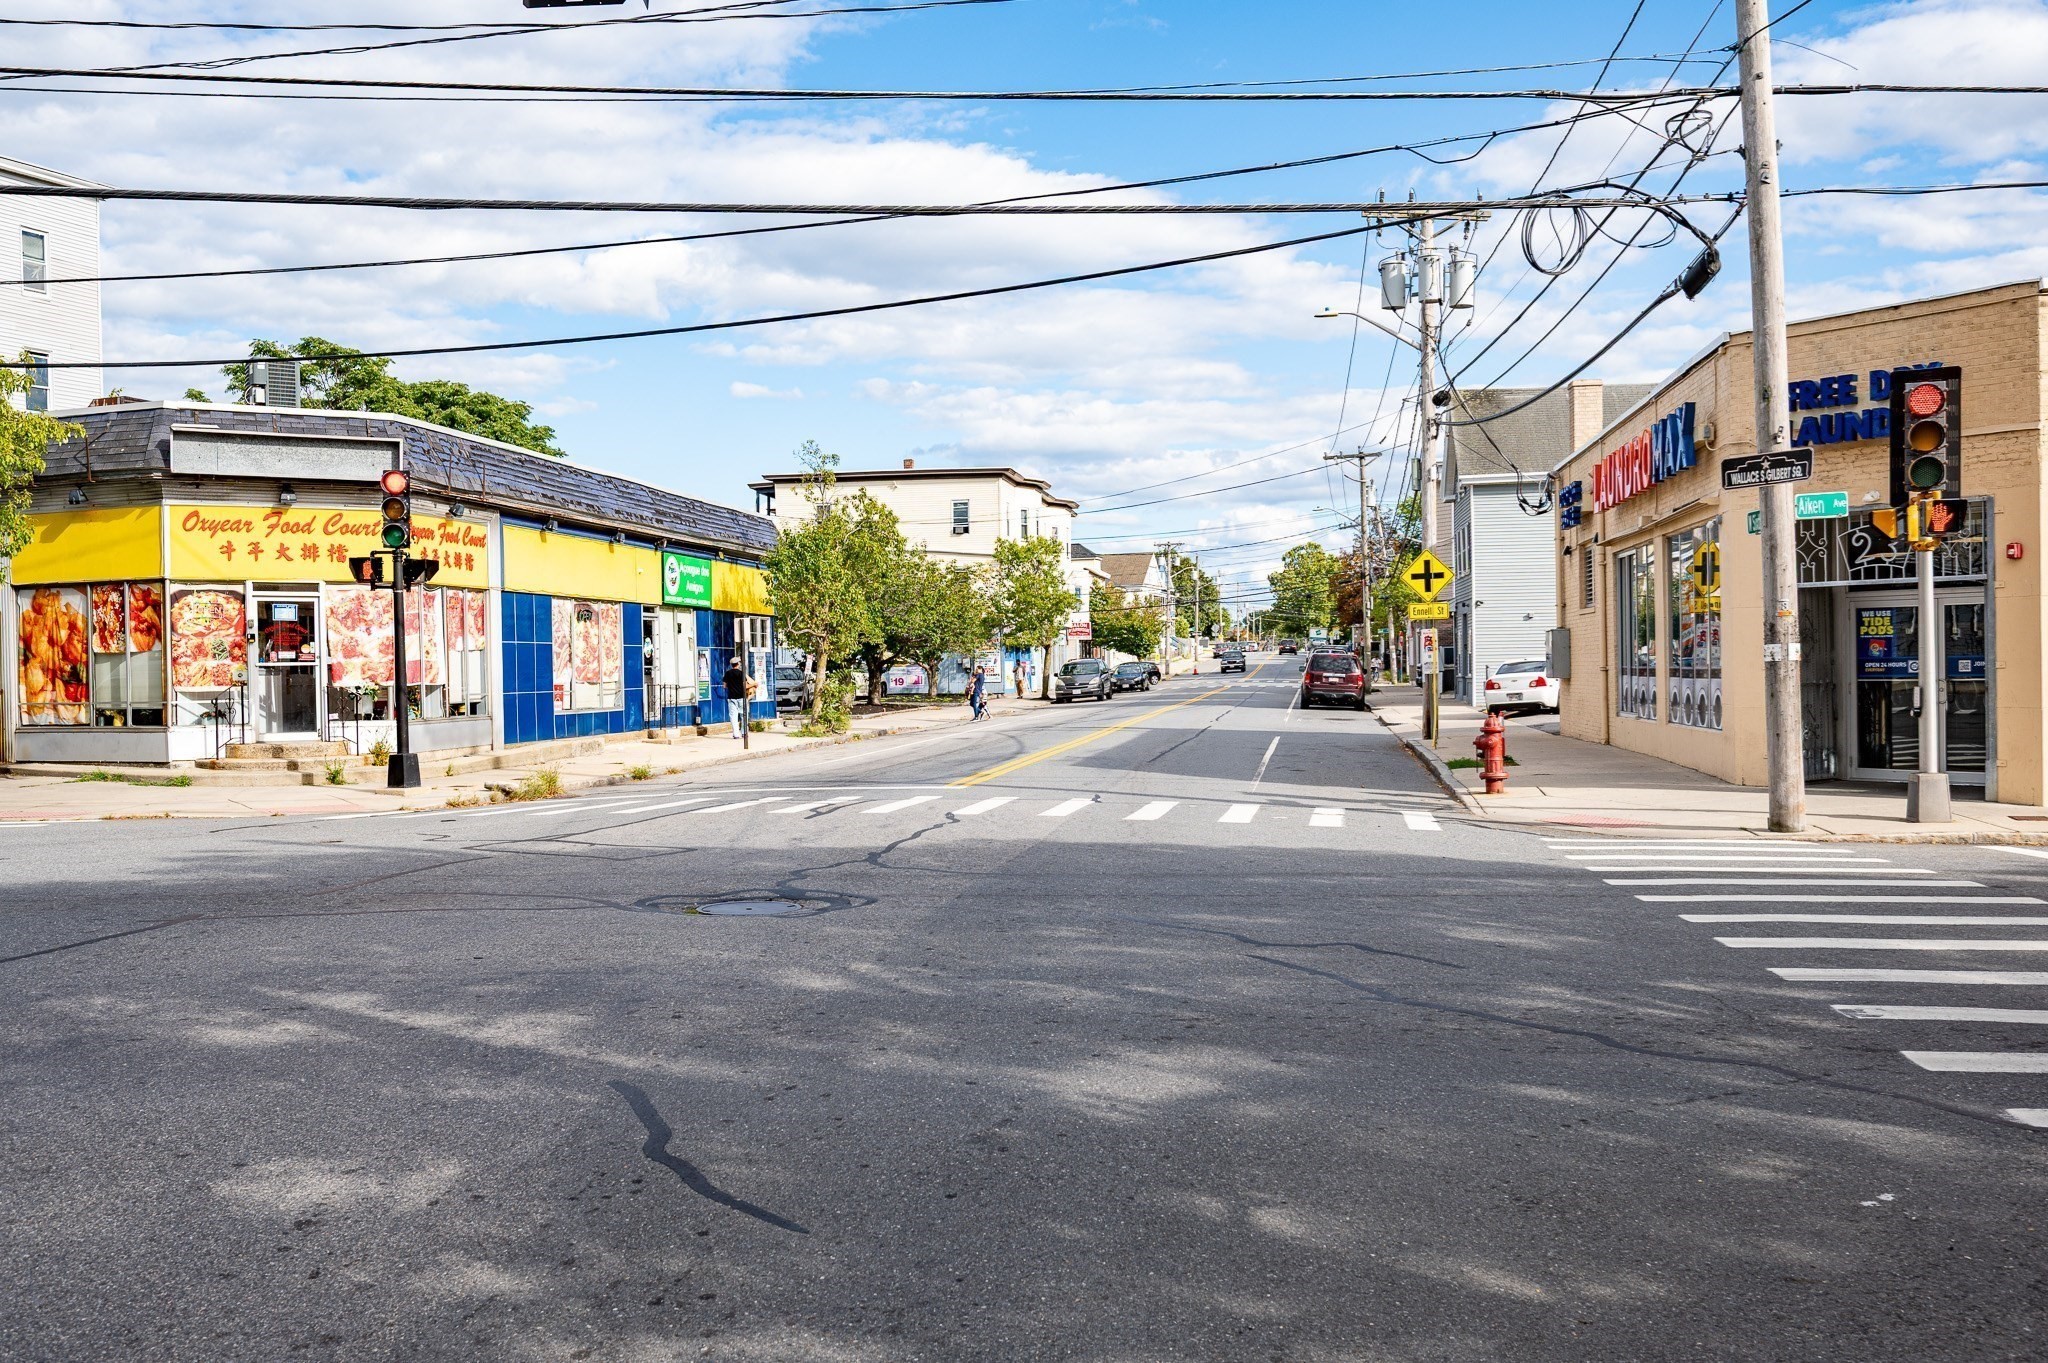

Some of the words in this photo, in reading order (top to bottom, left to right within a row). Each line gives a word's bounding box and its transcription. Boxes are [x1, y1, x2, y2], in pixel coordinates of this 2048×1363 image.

[1788, 374, 1858, 412] FREE
[1730, 470, 1760, 485] WALLACE
[1766, 467, 1791, 480] GILBERT
[1798, 497, 1825, 515] Aiken
[1833, 498, 1847, 509] Ave
[182, 510, 254, 539] Oxyear
[262, 511, 316, 538] Food
[323, 513, 381, 536] Court
[438, 523, 460, 545] Food
[463, 526, 487, 548] Court
[1413, 606, 1433, 615] Ennell
[1437, 606, 1444, 615] St
[1862, 617, 1891, 626] TIDE
